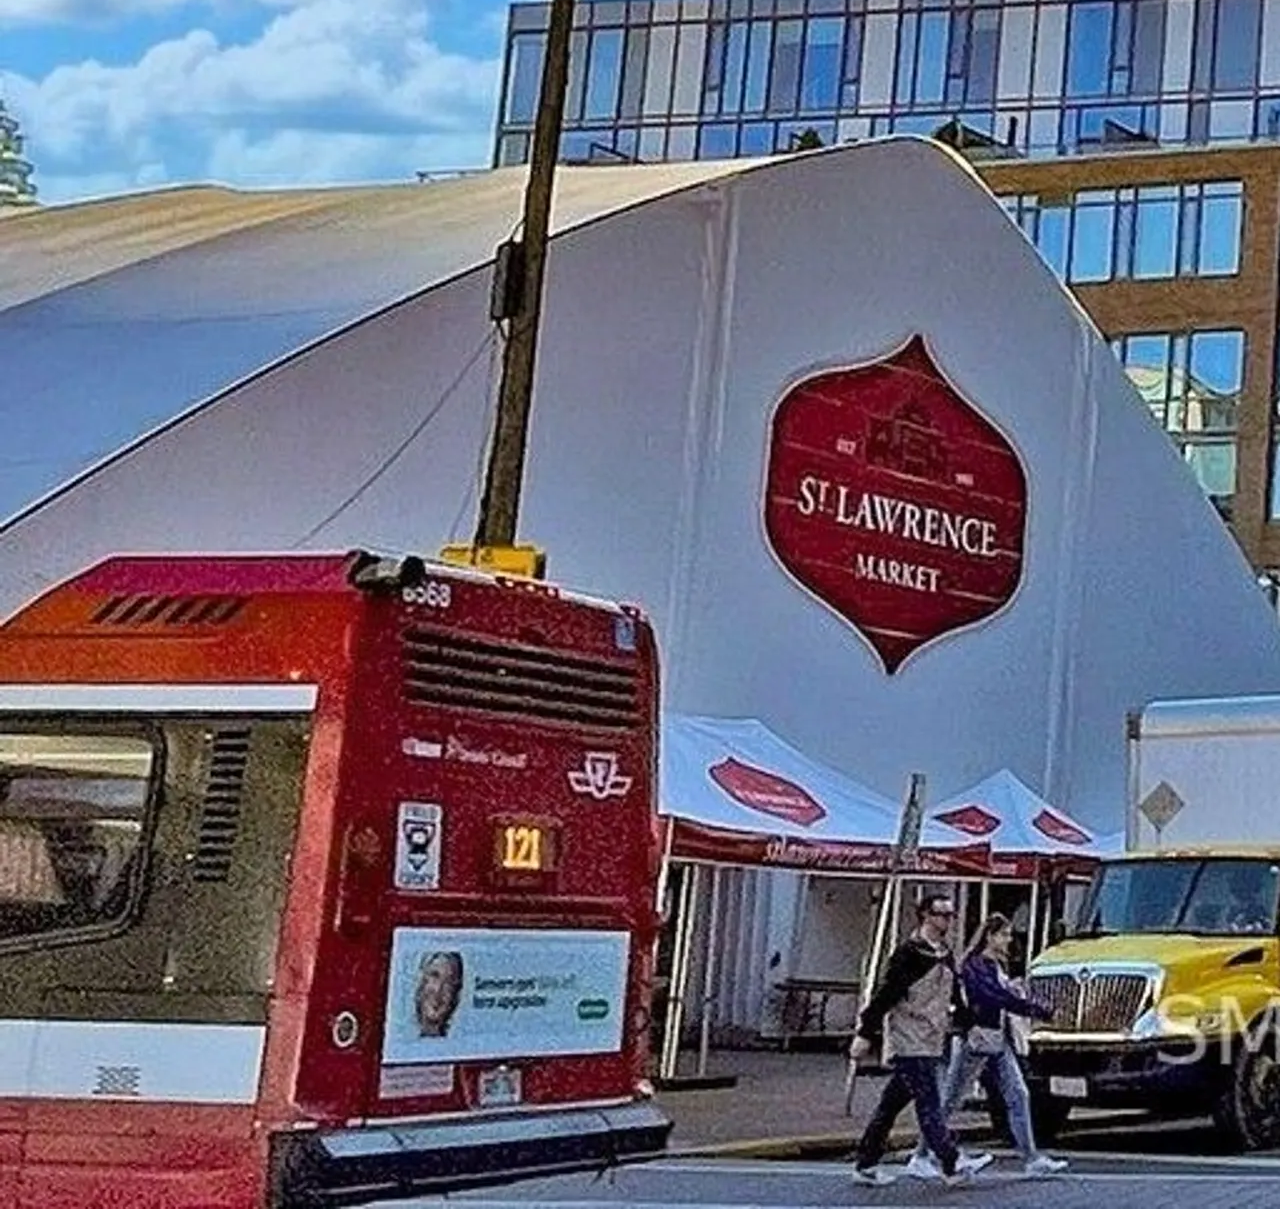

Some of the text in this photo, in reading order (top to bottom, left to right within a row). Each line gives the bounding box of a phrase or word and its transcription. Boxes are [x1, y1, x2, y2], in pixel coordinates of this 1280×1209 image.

[836, 485, 998, 557] LAWRENCE
[856, 553, 940, 592] MARKET
[502, 826, 541, 869] 121
